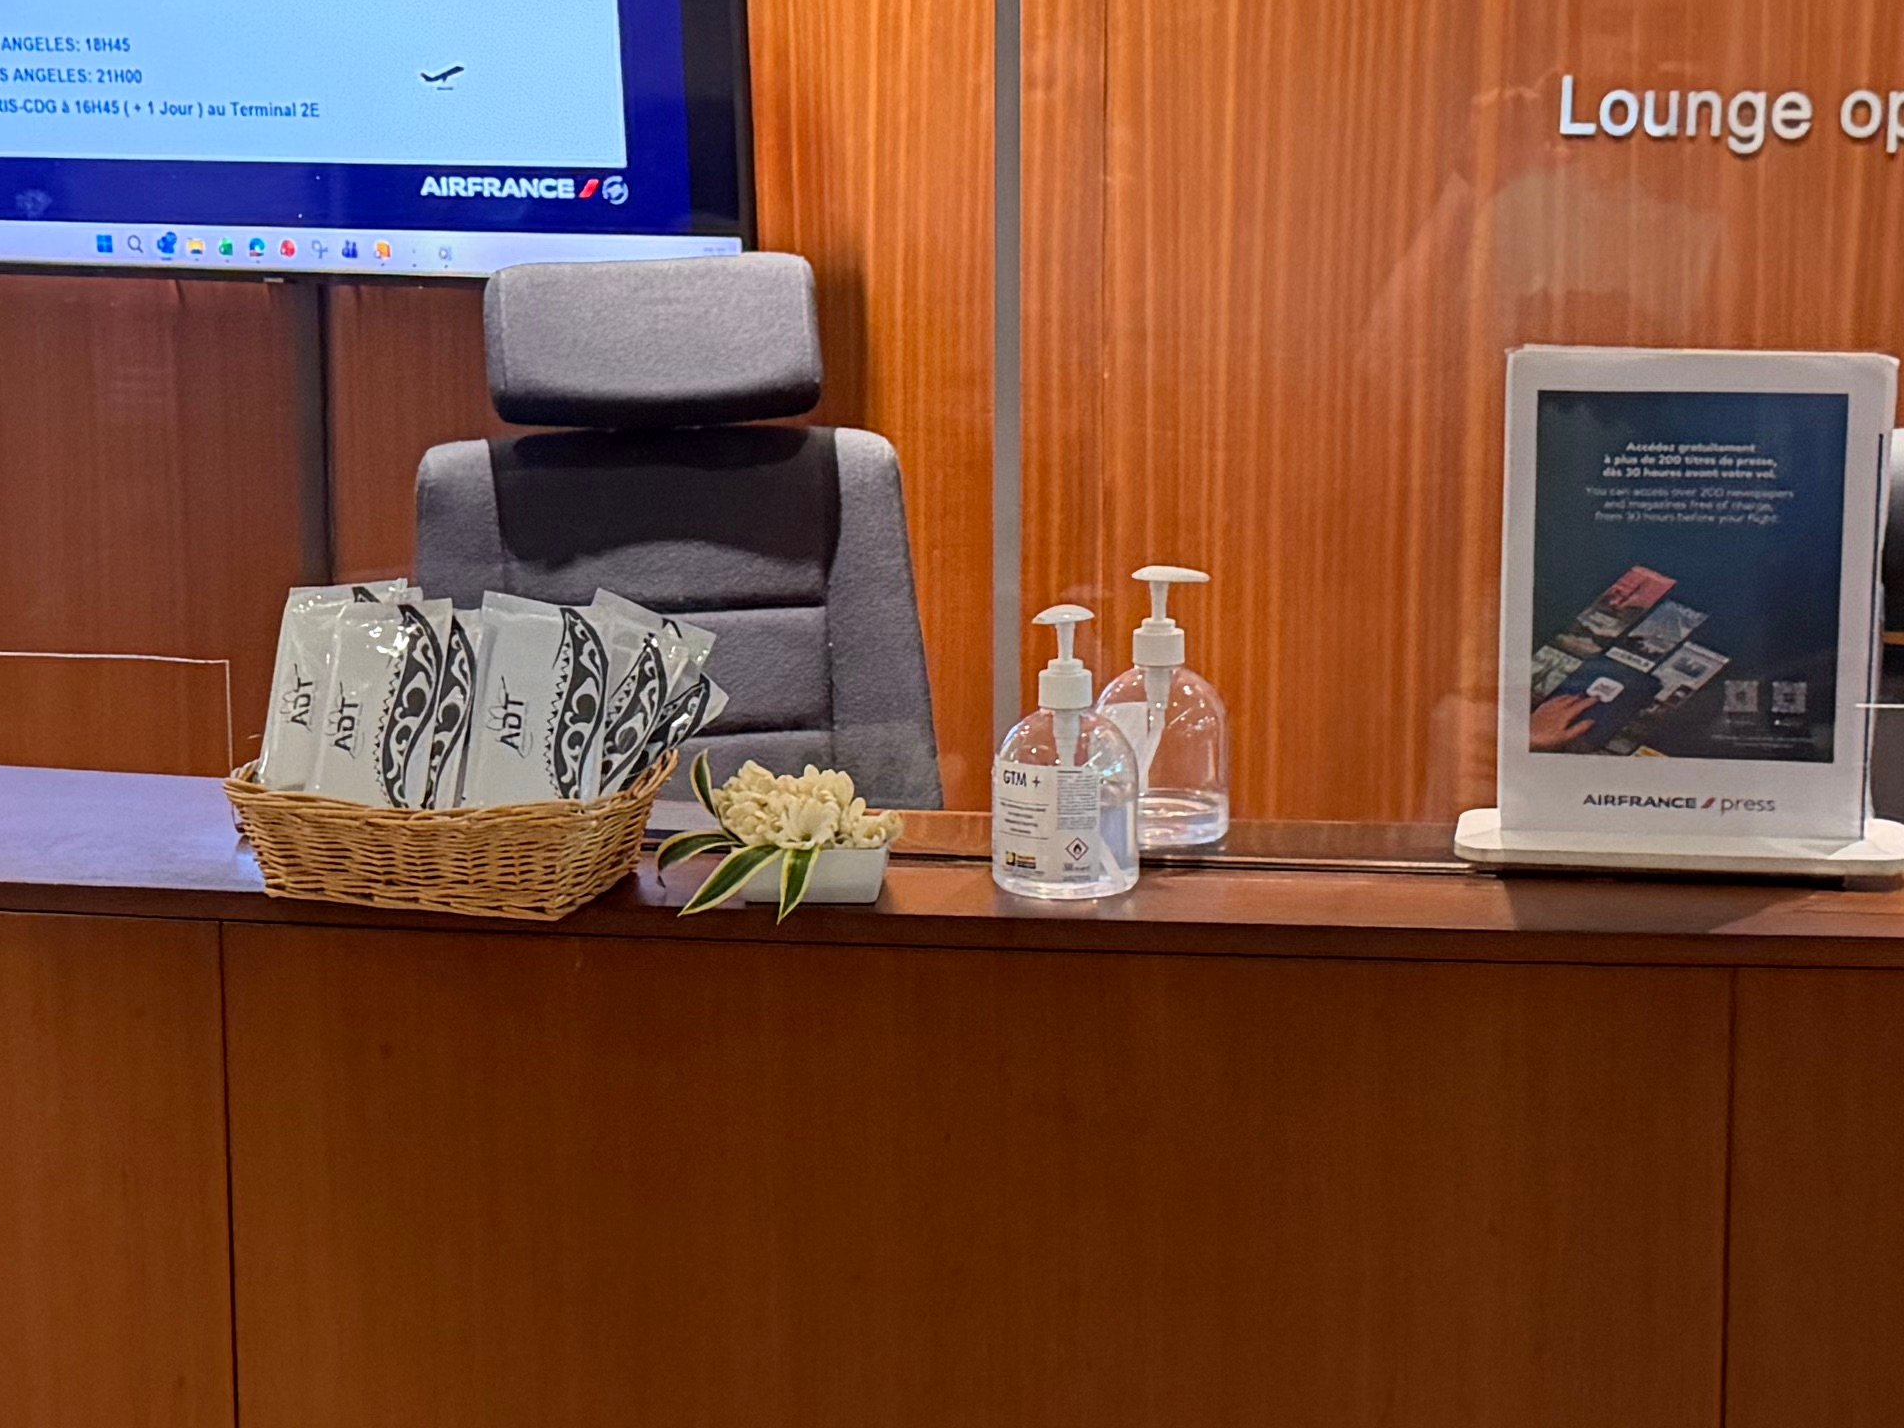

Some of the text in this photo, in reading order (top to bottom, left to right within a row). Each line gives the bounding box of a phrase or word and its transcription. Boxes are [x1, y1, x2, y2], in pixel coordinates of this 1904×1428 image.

[1, 36, 80, 52] ANGELES:
[13, 67, 92, 83] ANGELES:
[62, 99, 70, 114] à
[160, 101, 192, 116] Jour
[208, 105, 225, 117] au
[230, 102, 296, 118] Terminal
[302, 103, 320, 117] 2E
[1559, 75, 1813, 152] Lounge
[420, 176, 575, 199] AIRFRANCE
[1658, 456, 1681, 465] 200
[291, 677, 313, 727] ADT
[334, 697, 359, 750] ADT
[500, 692, 524, 749] ADT
[1583, 794, 1775, 814] AIRFRANCE press
